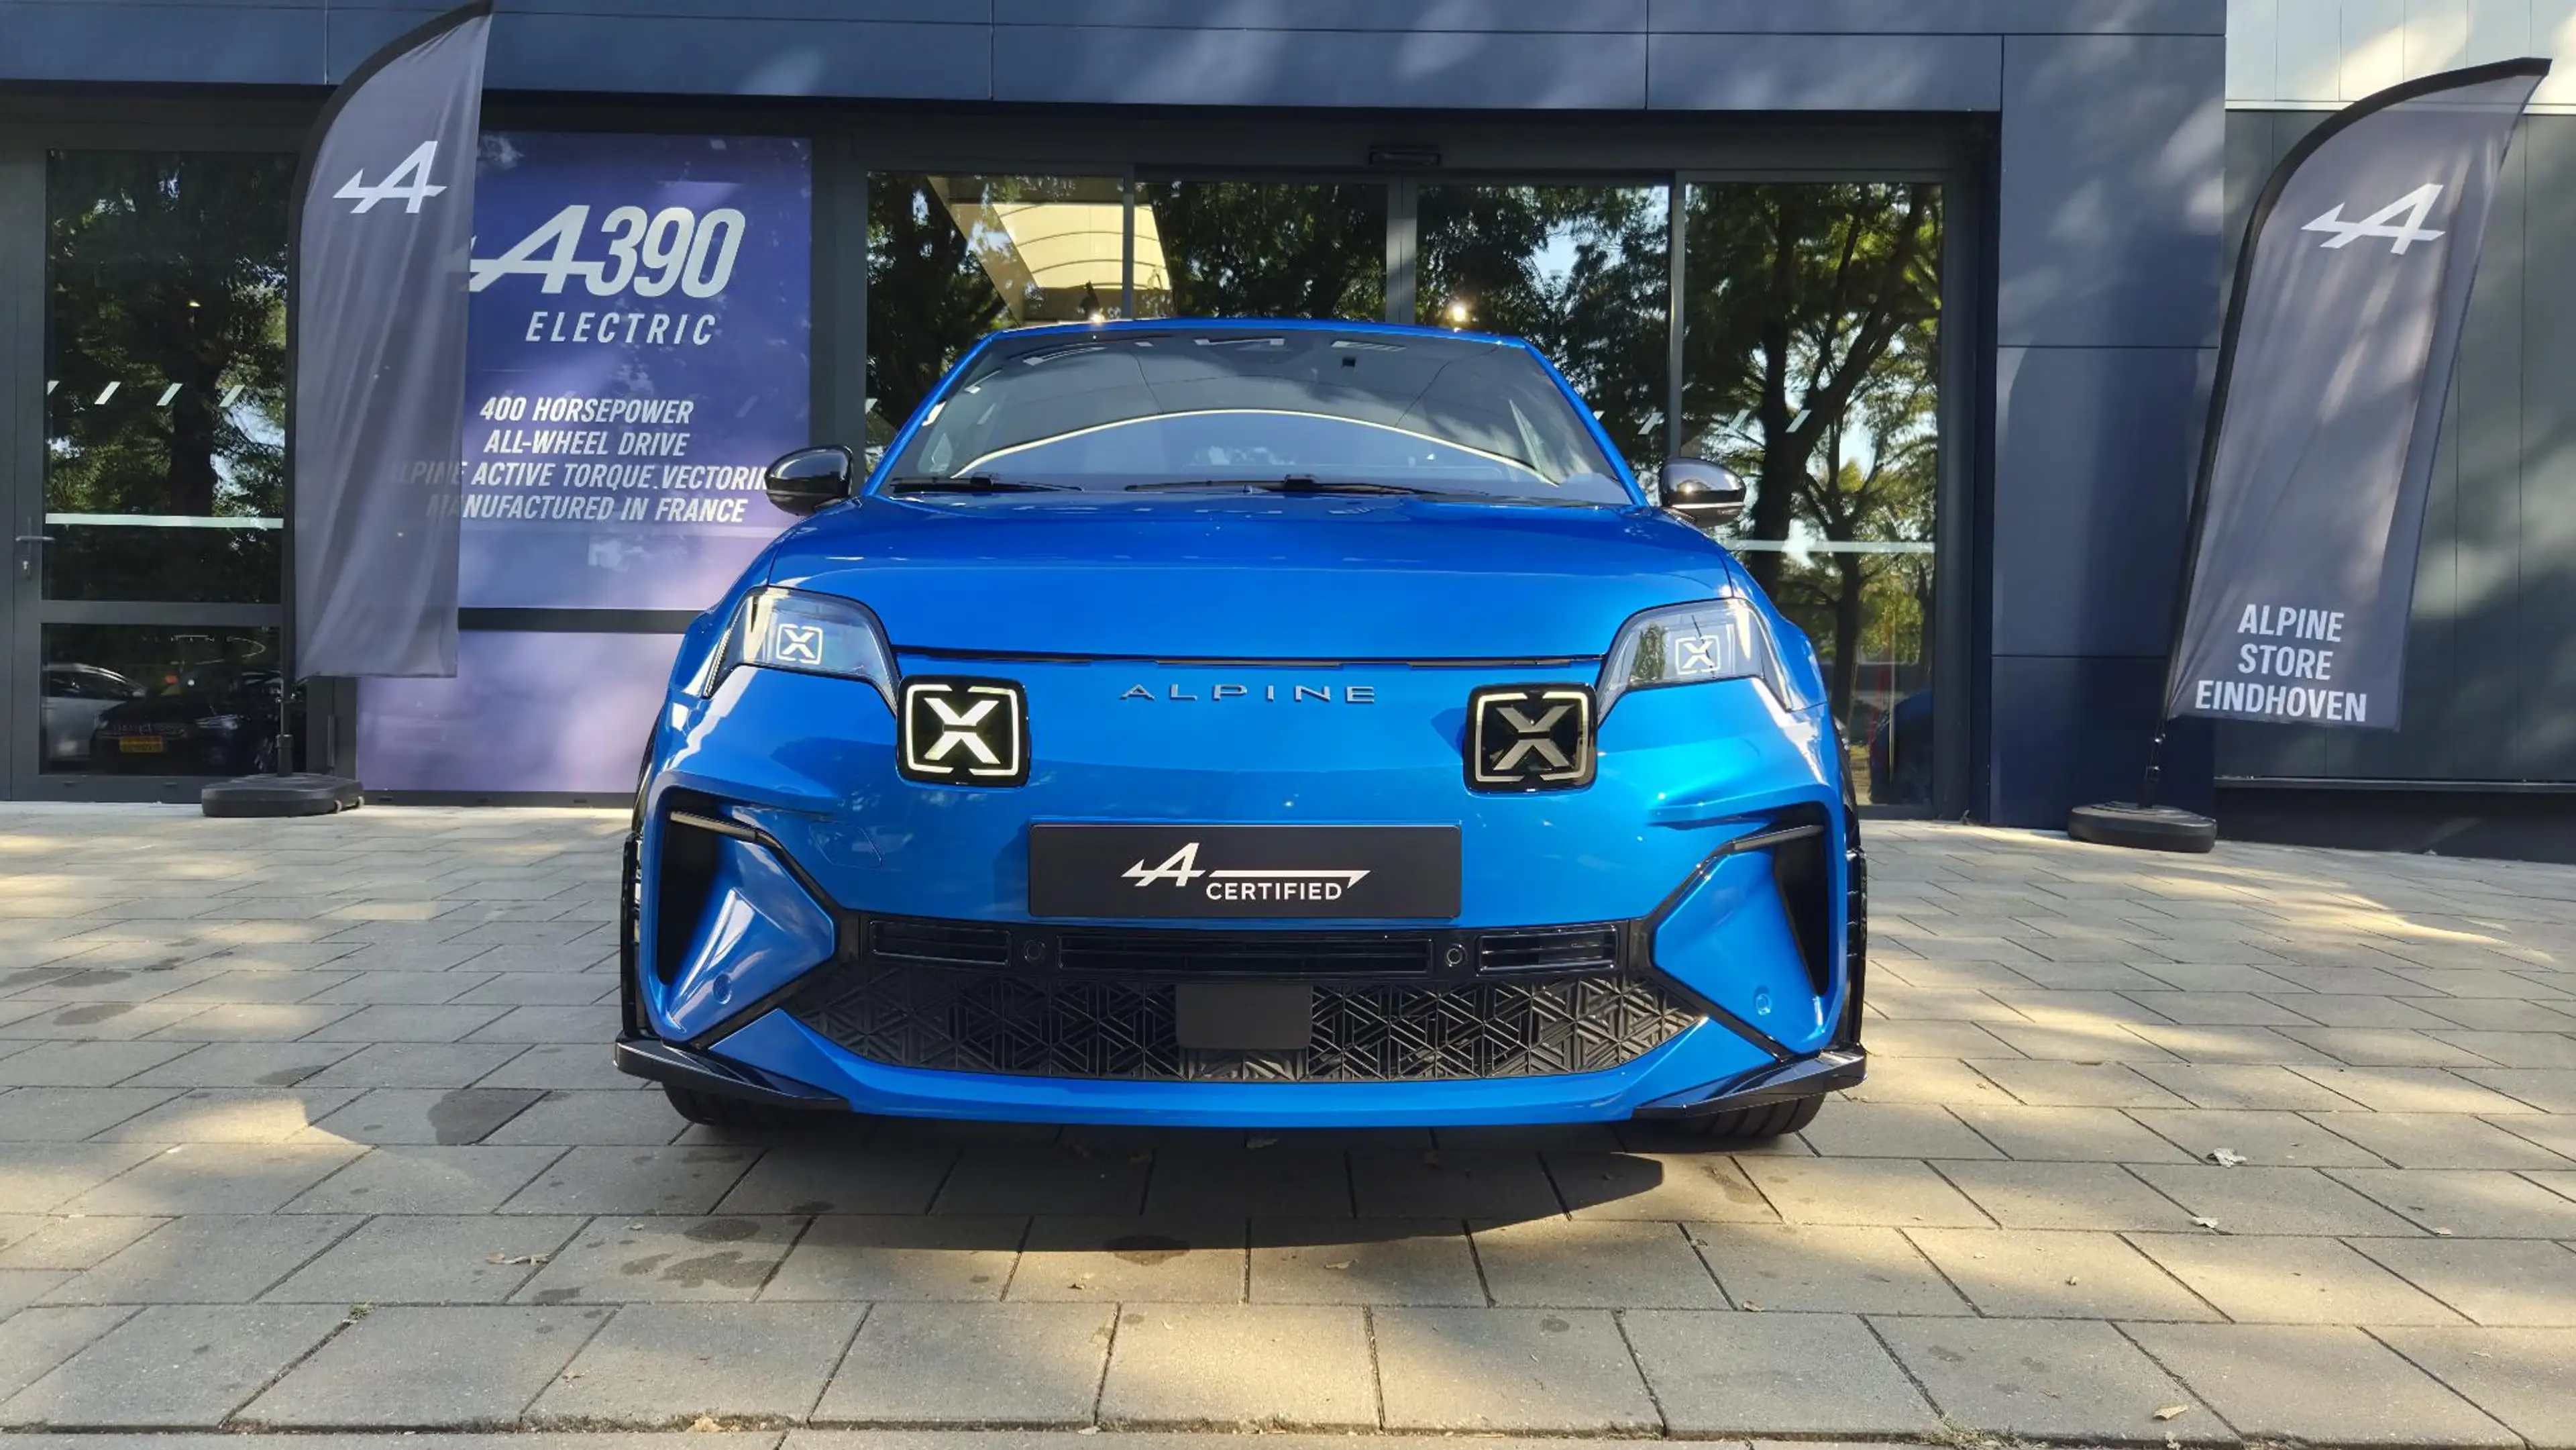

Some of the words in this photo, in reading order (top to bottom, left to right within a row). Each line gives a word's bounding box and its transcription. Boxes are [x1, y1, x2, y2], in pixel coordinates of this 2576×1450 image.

[467, 204, 746, 299] A390
[525, 311, 716, 346] ELECTRIC
[479, 395, 527, 421] 400
[531, 396, 694, 425] HORSEPOWER
[483, 429, 608, 456] ALL-WHEEL
[617, 432, 690, 457] DRIVE
[471, 461, 556, 487] ACTIVE
[562, 463, 655, 491] TORQUE
[661, 465, 767, 491] VECTORIN
[620, 497, 650, 521] IN
[655, 497, 748, 523] FRANCE
[2237, 603, 2345, 643] ALPINE
[2237, 642, 2334, 680] STORE
[1119, 683, 1376, 703] ALPINE
[2194, 679, 2367, 723] EINDHOVEN
[1205, 882, 1342, 901] CERTIFIED
